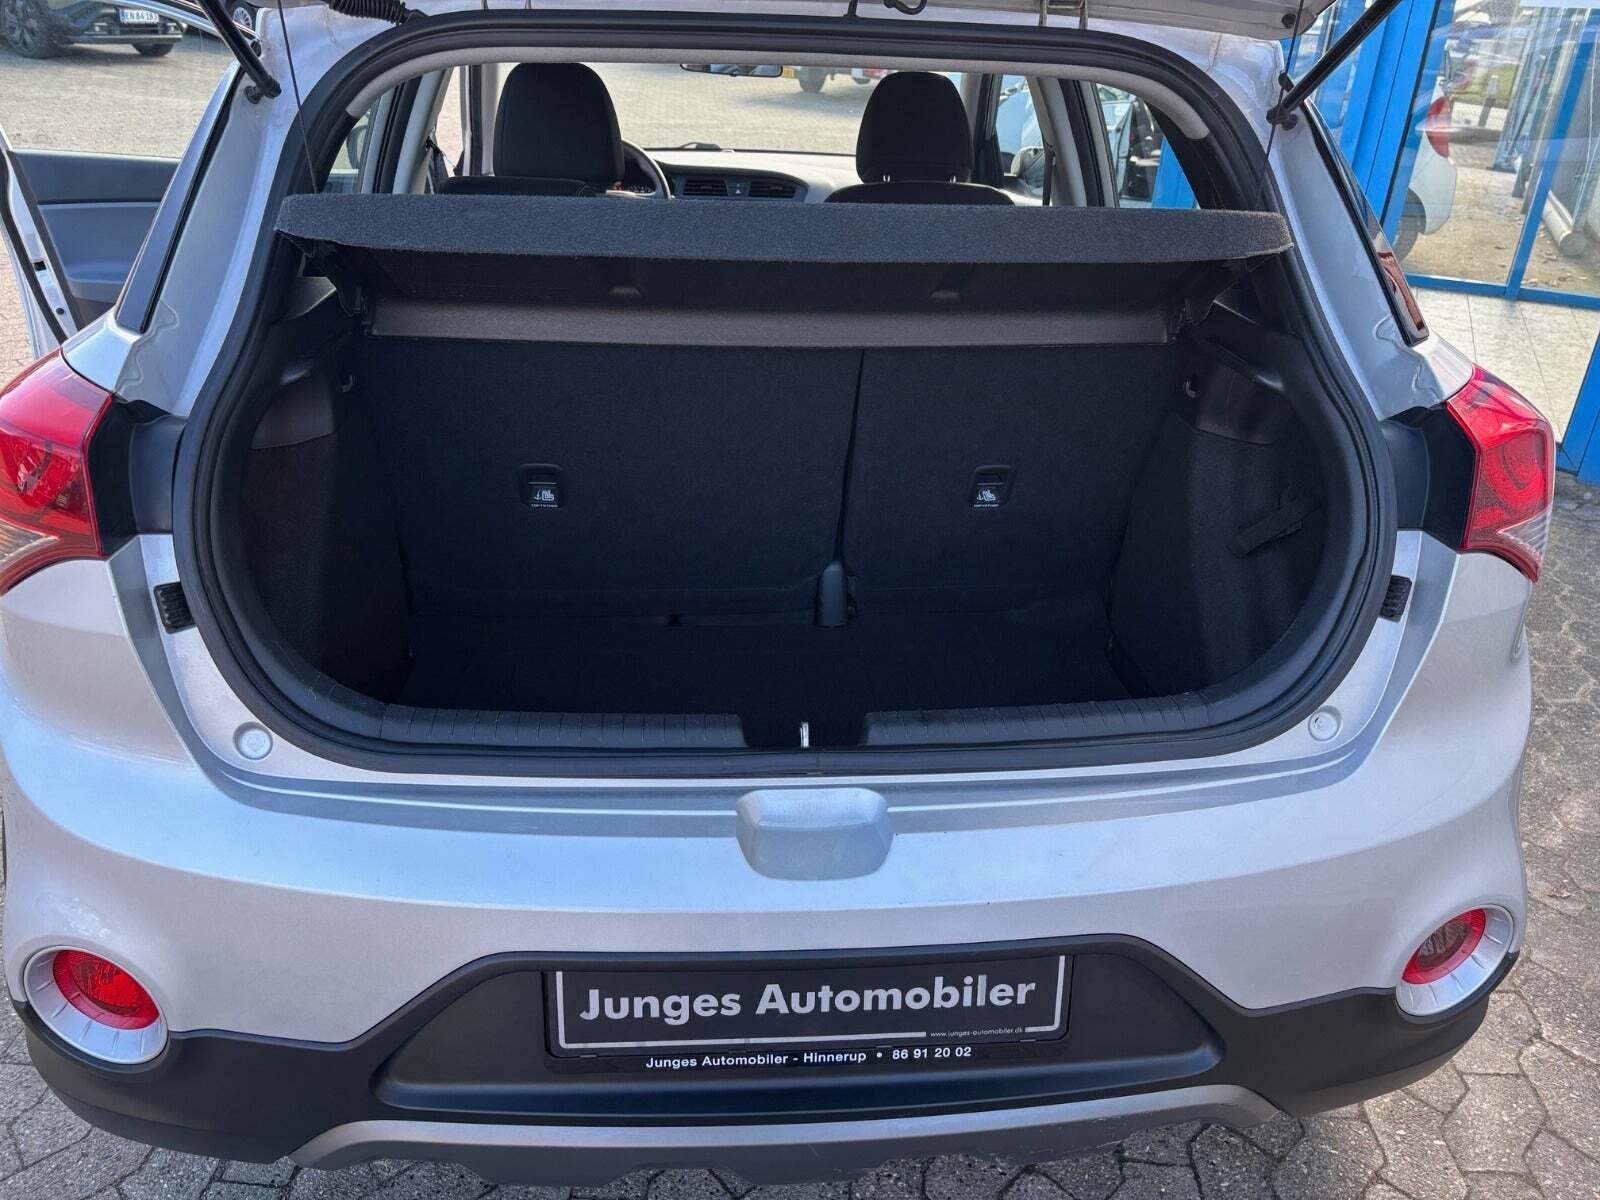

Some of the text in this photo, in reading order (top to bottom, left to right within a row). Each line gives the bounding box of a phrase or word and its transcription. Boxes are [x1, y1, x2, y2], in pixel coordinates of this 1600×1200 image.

[579, 974, 1037, 1026] Junges Automobiler
[645, 1057, 698, 1069] Junges
[702, 1053, 789, 1067] Automobiler
[803, 1052, 867, 1063] Hinnerup
[892, 1048, 909, 1060] 86
[913, 1048, 928, 1059] 91
[934, 1047, 951, 1058] 20
[955, 1046, 972, 1057] 02
